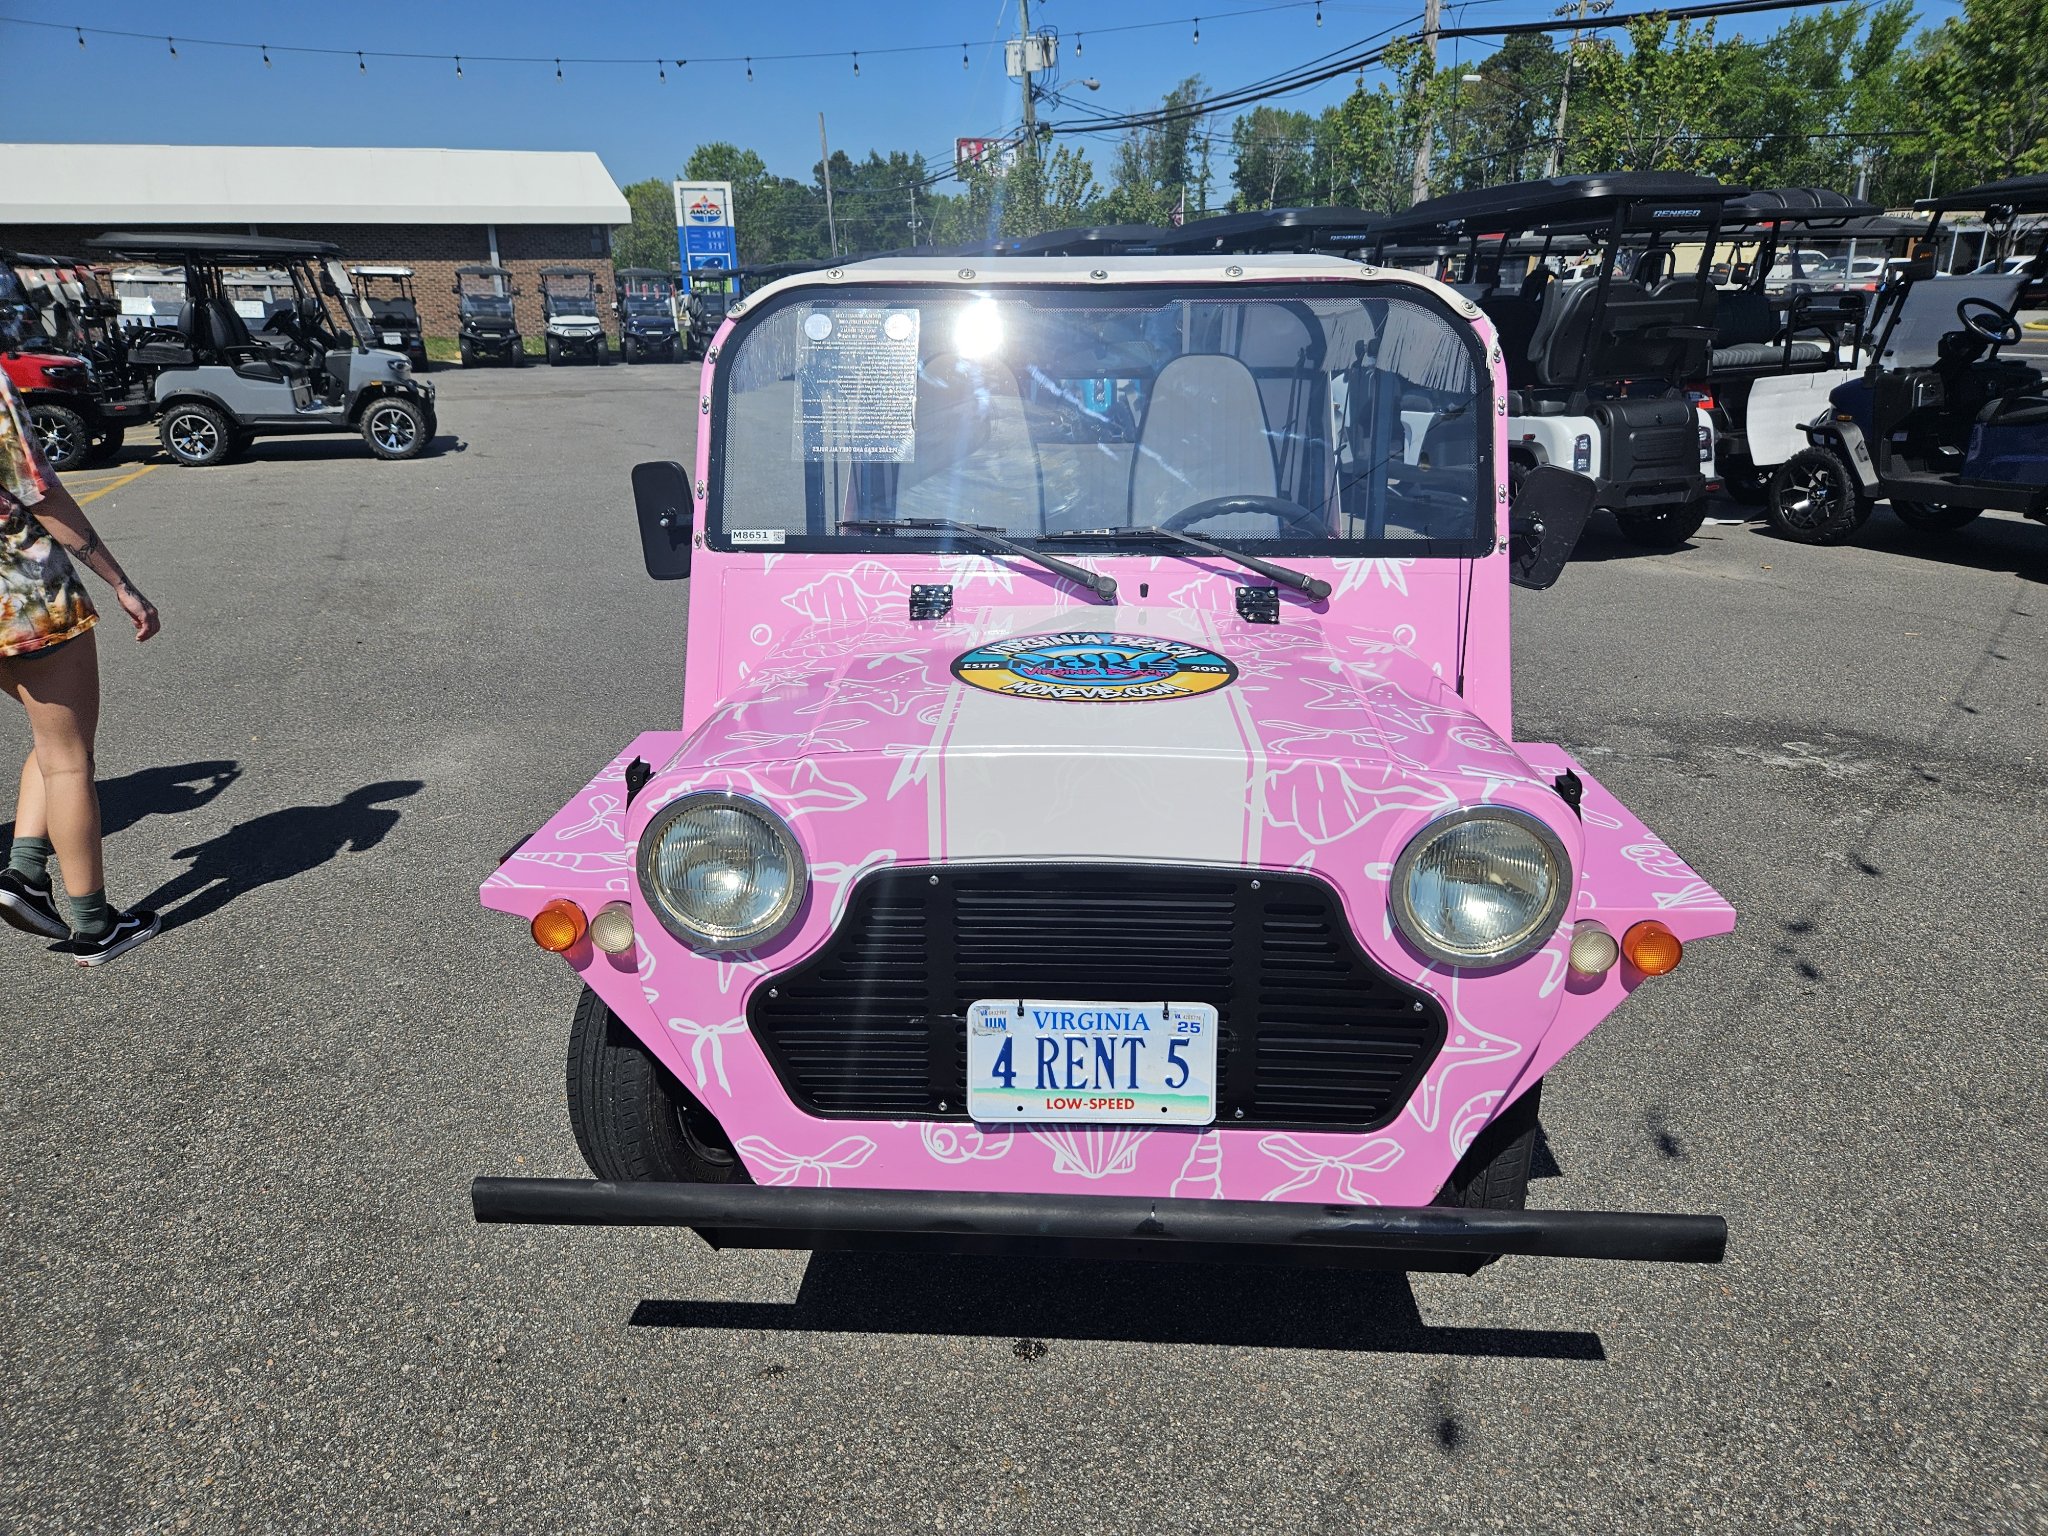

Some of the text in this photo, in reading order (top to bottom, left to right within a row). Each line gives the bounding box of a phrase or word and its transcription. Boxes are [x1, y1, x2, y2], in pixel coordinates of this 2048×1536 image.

[733, 531, 768, 539] M8651
[979, 634, 1208, 658] VIRGINIA BEACH
[1106, 668, 1170, 677] BEACH
[1001, 681, 1194, 699] MOKEVB.COM
[1033, 1011, 1150, 1031] VIRGINIA
[1177, 1021, 1201, 1034] 25
[991, 1034, 1191, 1090] 4 RENT 5
[1046, 1098, 1135, 1110] LOW-SPEED
